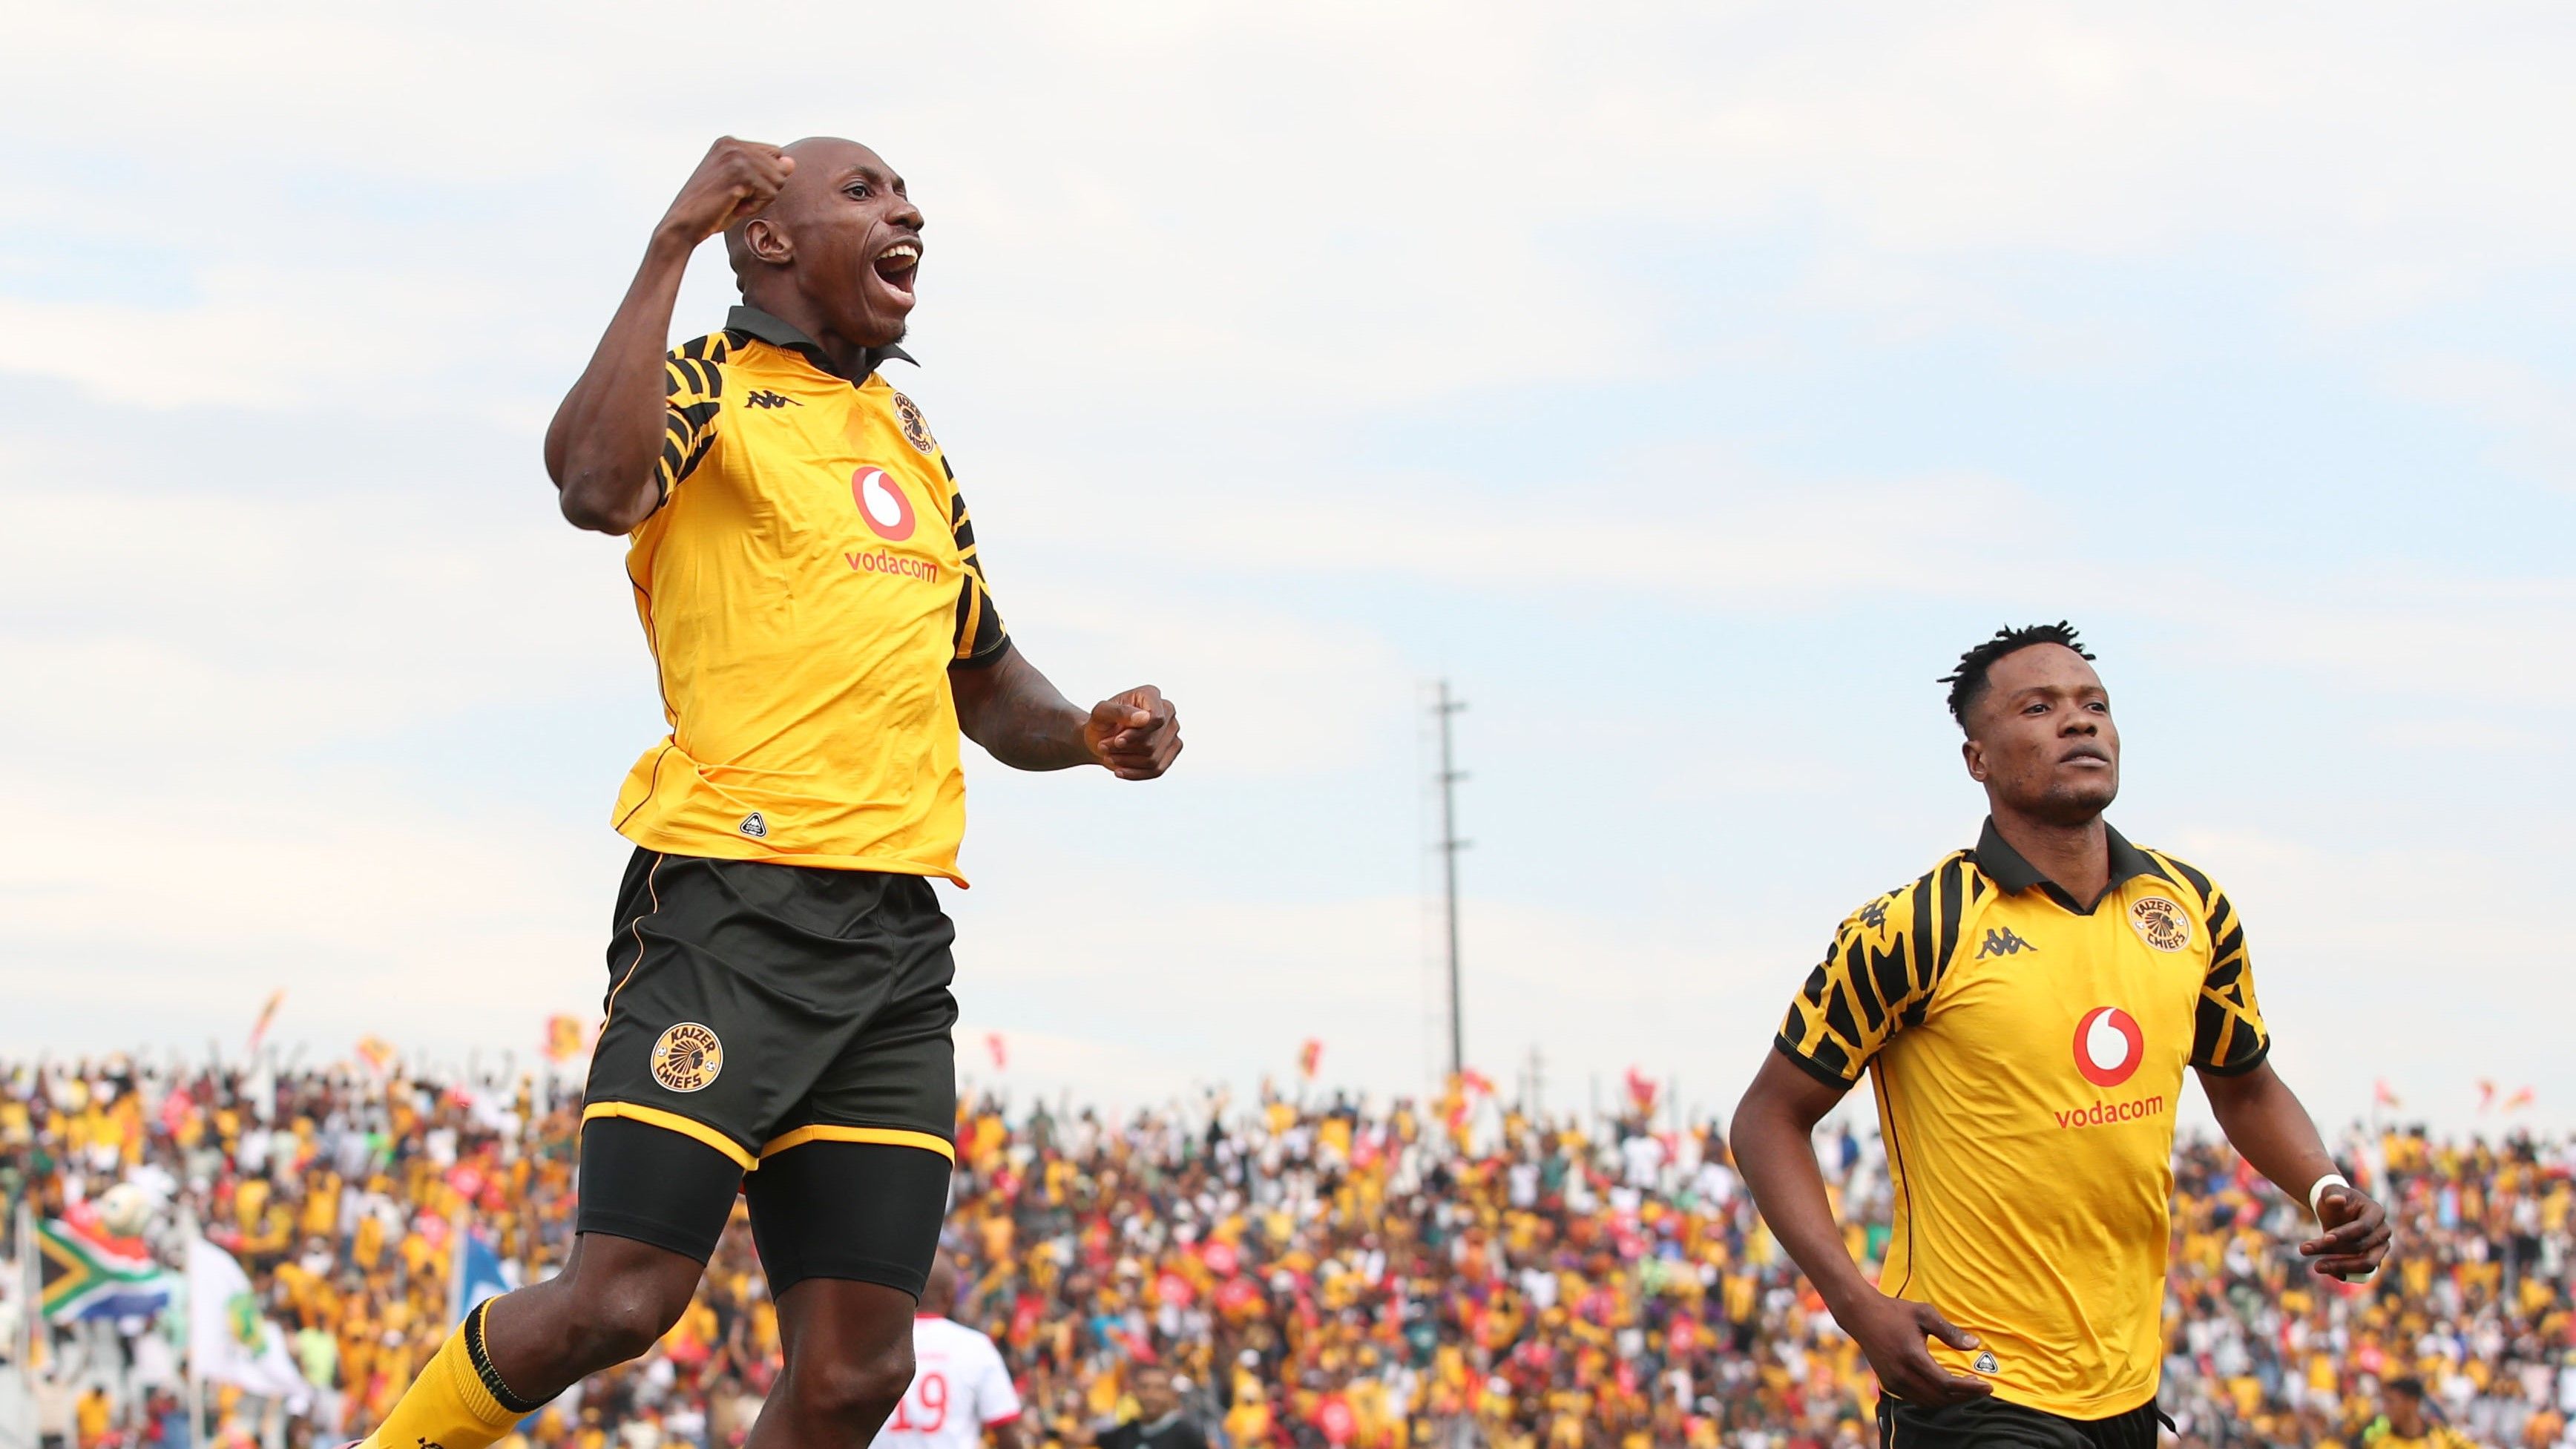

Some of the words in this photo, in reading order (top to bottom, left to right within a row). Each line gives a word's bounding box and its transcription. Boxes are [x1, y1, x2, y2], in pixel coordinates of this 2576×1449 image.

[844, 549, 937, 584] vodacom
[2134, 901, 2172, 919] KAIZER
[2147, 931, 2186, 949] CHIEFS
[671, 1027, 716, 1054] KAIZER
[656, 1062, 702, 1088] CHIEFS
[2054, 1095, 2163, 1128] vodacom
[890, 1373, 948, 1433] 19
